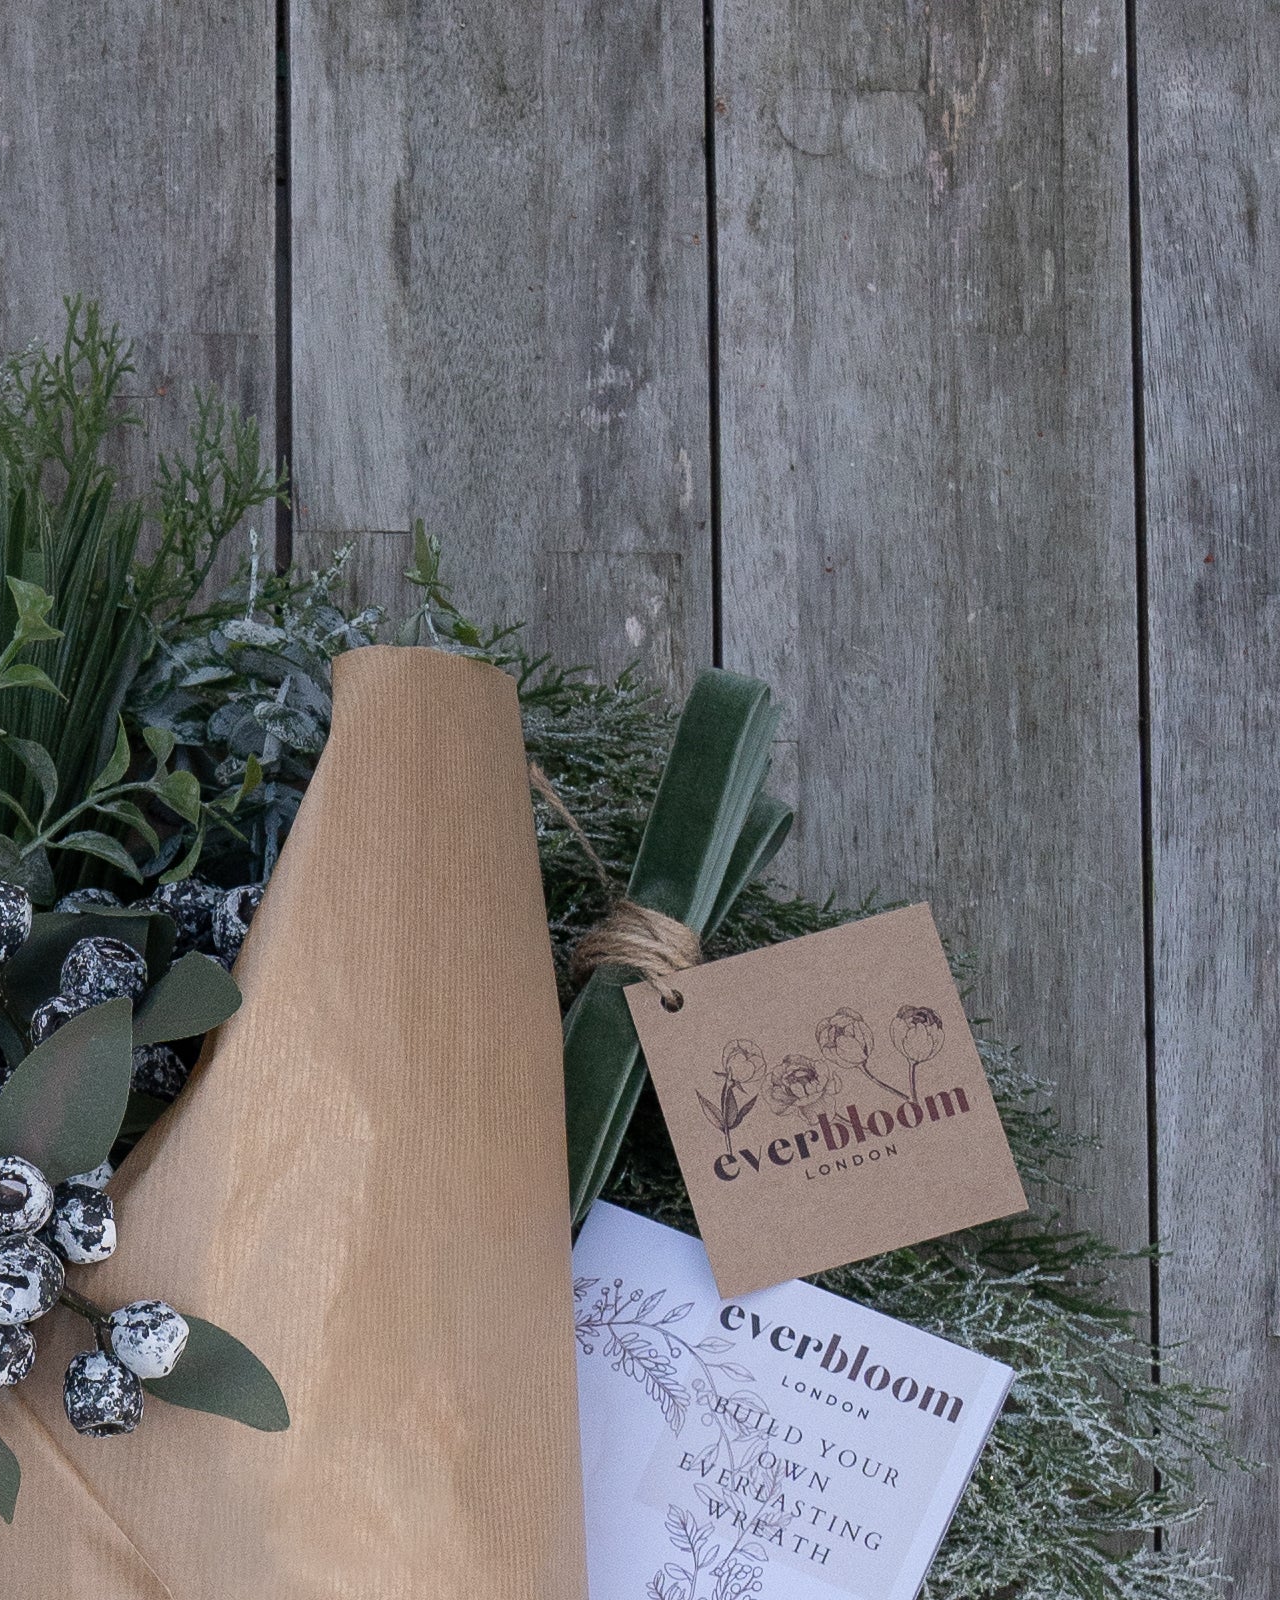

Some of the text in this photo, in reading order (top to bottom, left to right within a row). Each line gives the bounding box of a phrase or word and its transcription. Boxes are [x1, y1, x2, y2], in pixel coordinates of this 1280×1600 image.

[713, 1087, 970, 1181] everbloom
[806, 1144, 899, 1180] LONDON
[720, 1304, 964, 1423] everbloom
[781, 1375, 871, 1421] LONDON
[713, 1396, 900, 1489] BUILD YOUR
[758, 1451, 832, 1494] OWN
[679, 1452, 883, 1551] EVERLASTING
[707, 1499, 831, 1565] WREATH
